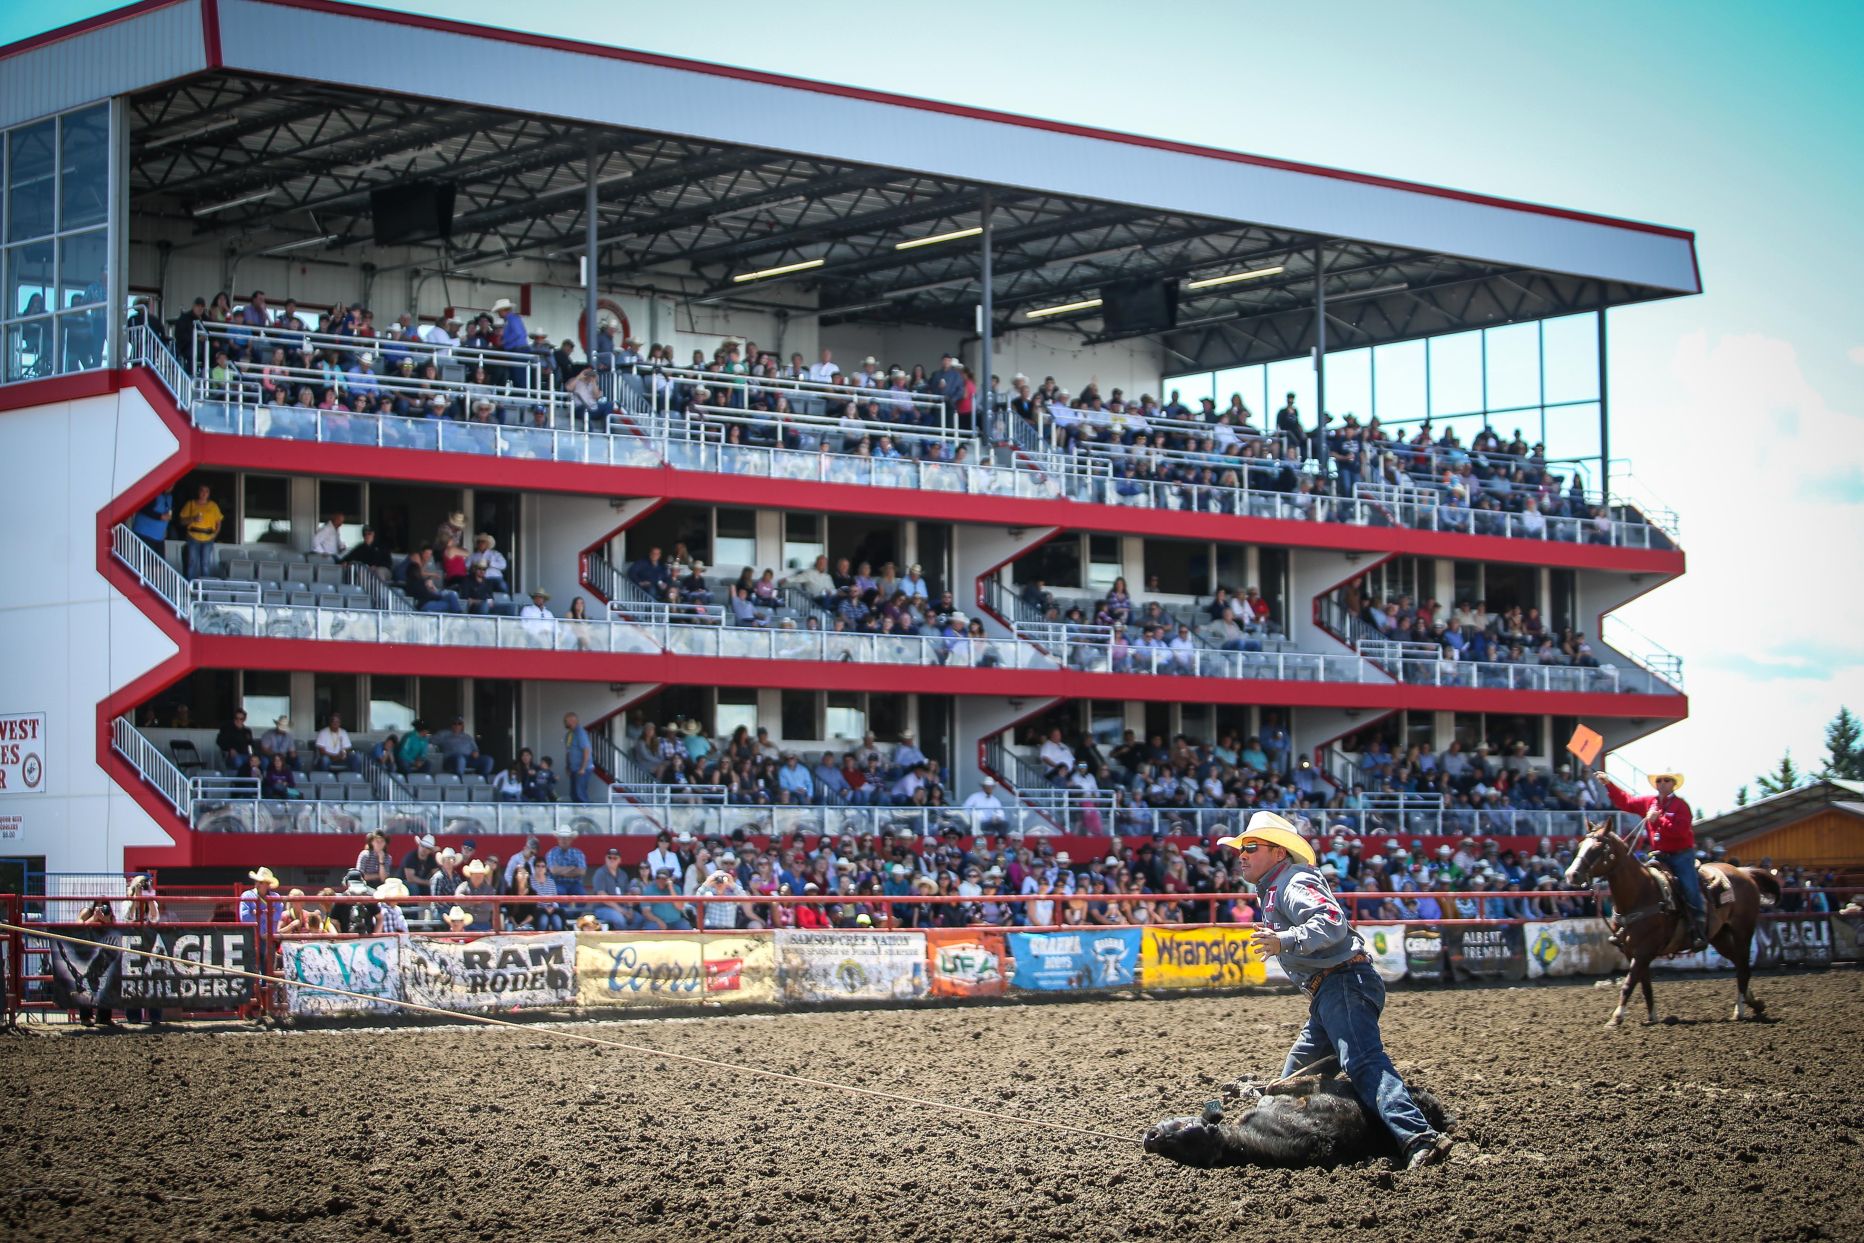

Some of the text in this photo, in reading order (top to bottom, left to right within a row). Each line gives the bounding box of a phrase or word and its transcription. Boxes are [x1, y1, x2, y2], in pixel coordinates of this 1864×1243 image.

[121, 933, 246, 977] EAGLE
[463, 944, 566, 971] RAM
[790, 934, 911, 946] SAMSON CREE NATION
[1153, 932, 1249, 982] Wrangler
[295, 942, 391, 986] CVS
[607, 946, 701, 993] Coors
[940, 953, 999, 974] UFA
[120, 979, 247, 999] BUILDERS
